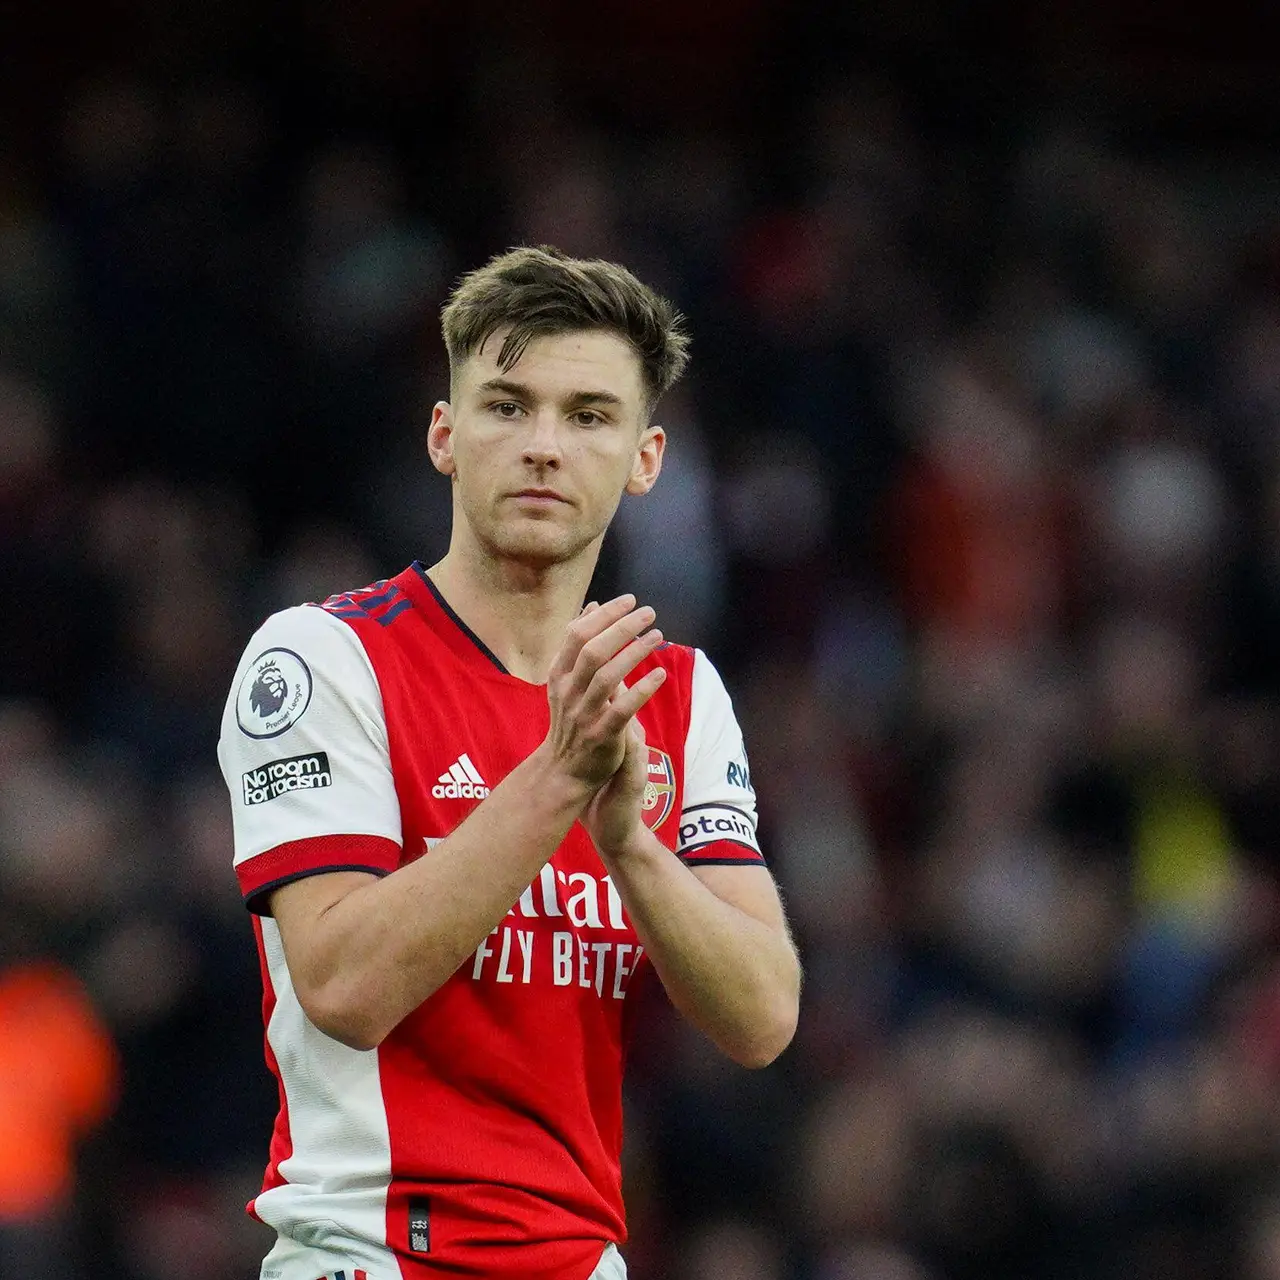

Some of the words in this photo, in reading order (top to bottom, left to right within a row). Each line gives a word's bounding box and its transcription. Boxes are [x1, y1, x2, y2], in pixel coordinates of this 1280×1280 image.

[266, 711, 290, 730] Premier
[288, 683, 303, 711] League
[243, 770, 267, 790] No
[268, 758, 320, 781] room
[270, 772, 330, 797] racism
[679, 815, 752, 845] ptain
[472, 927, 534, 984] FLY
